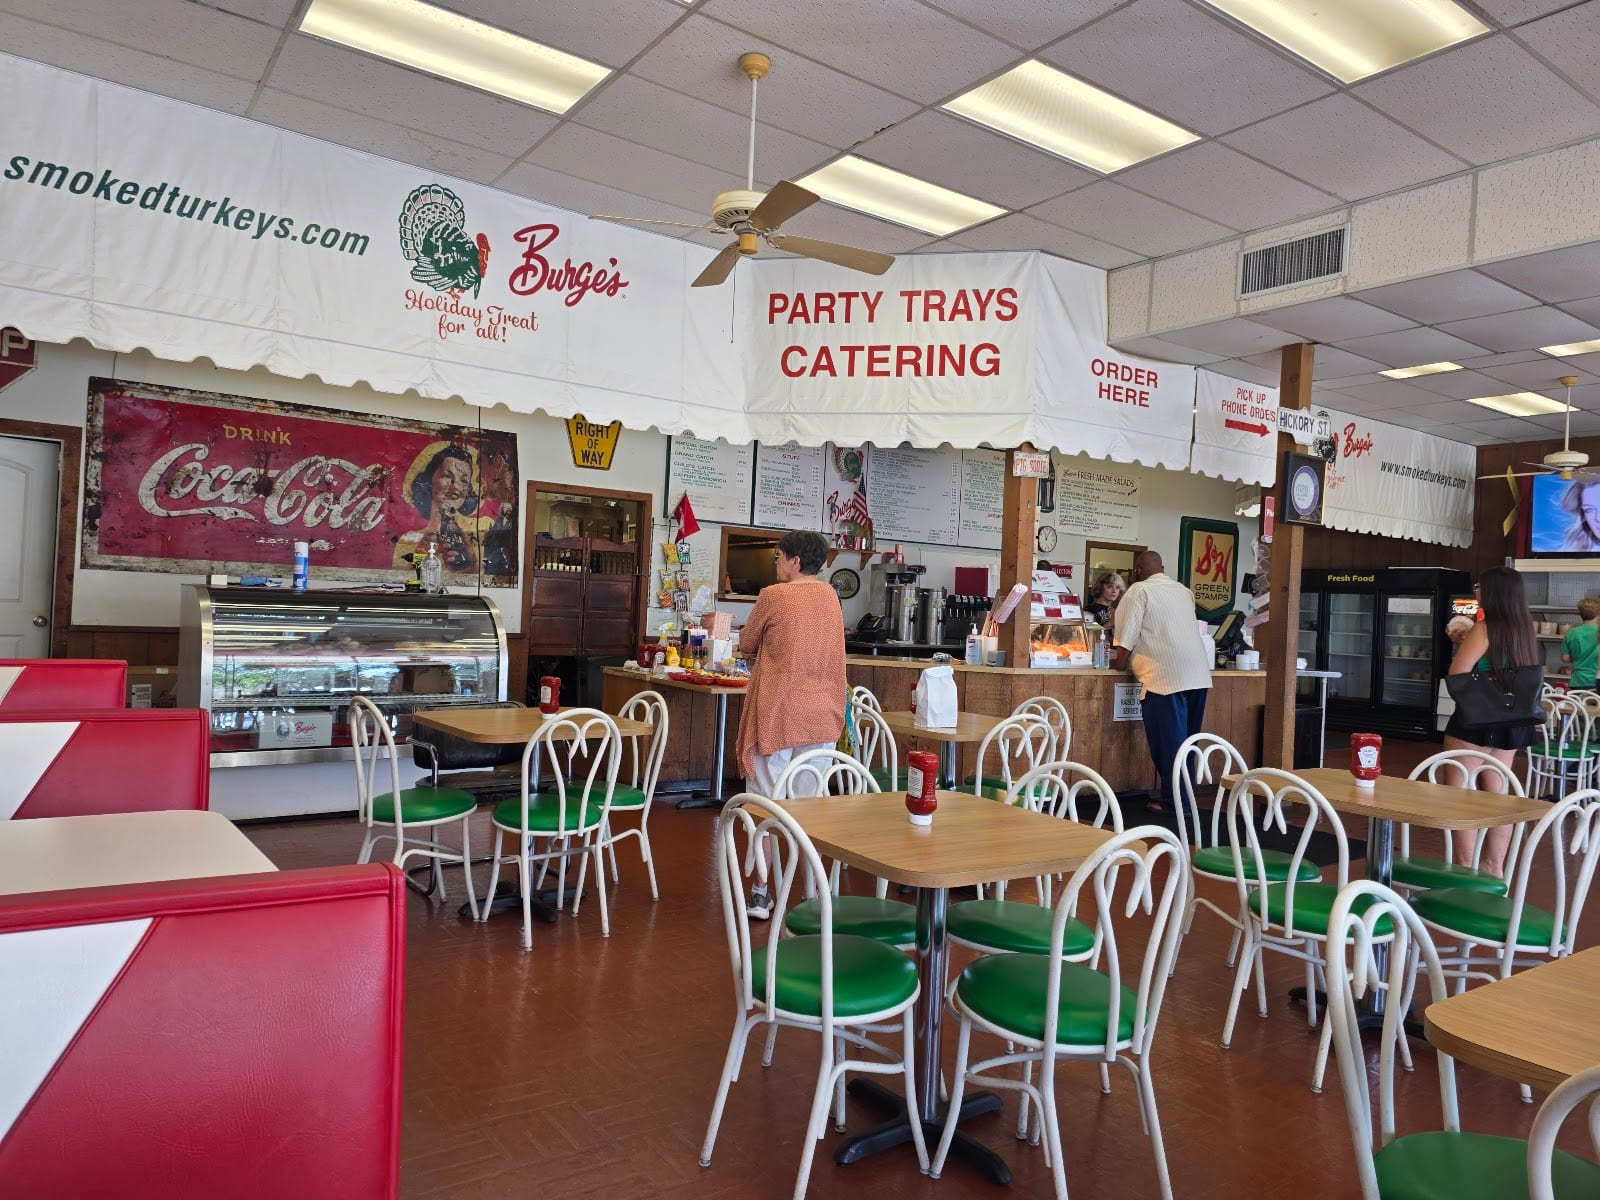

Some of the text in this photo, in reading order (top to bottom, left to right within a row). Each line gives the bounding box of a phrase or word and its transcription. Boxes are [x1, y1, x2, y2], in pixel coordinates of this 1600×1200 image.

[3, 155, 371, 257] smokedturkeys.com
[508, 223, 629, 307] Burge's
[404, 289, 539, 331] Holiday Treat
[768, 287, 1018, 324] PARTY TRAYS
[438, 313, 507, 343] for all!
[780, 342, 1001, 378] CATERING
[1091, 358, 1158, 388] ORDER
[1098, 382, 1150, 408] HERE
[1236, 387, 1266, 404] PICK UP
[1221, 399, 1247, 415] PHONE
[575, 421, 611, 439] RIGHT
[1279, 411, 1315, 433] HICKORY
[223, 424, 292, 446] DRINK
[587, 438, 599, 449] OF
[581, 449, 605, 465] WAY
[1077, 471, 1095, 481] FRESH
[1113, 477, 1135, 488] SALADS
[1380, 460, 1467, 490] www.smokedturkeys.com
[138, 443, 396, 532] Coca-Cola
[1194, 583, 1230, 593] GREEN
[1327, 574, 1351, 582] Fresh
[1194, 592, 1229, 602] STAMPS
